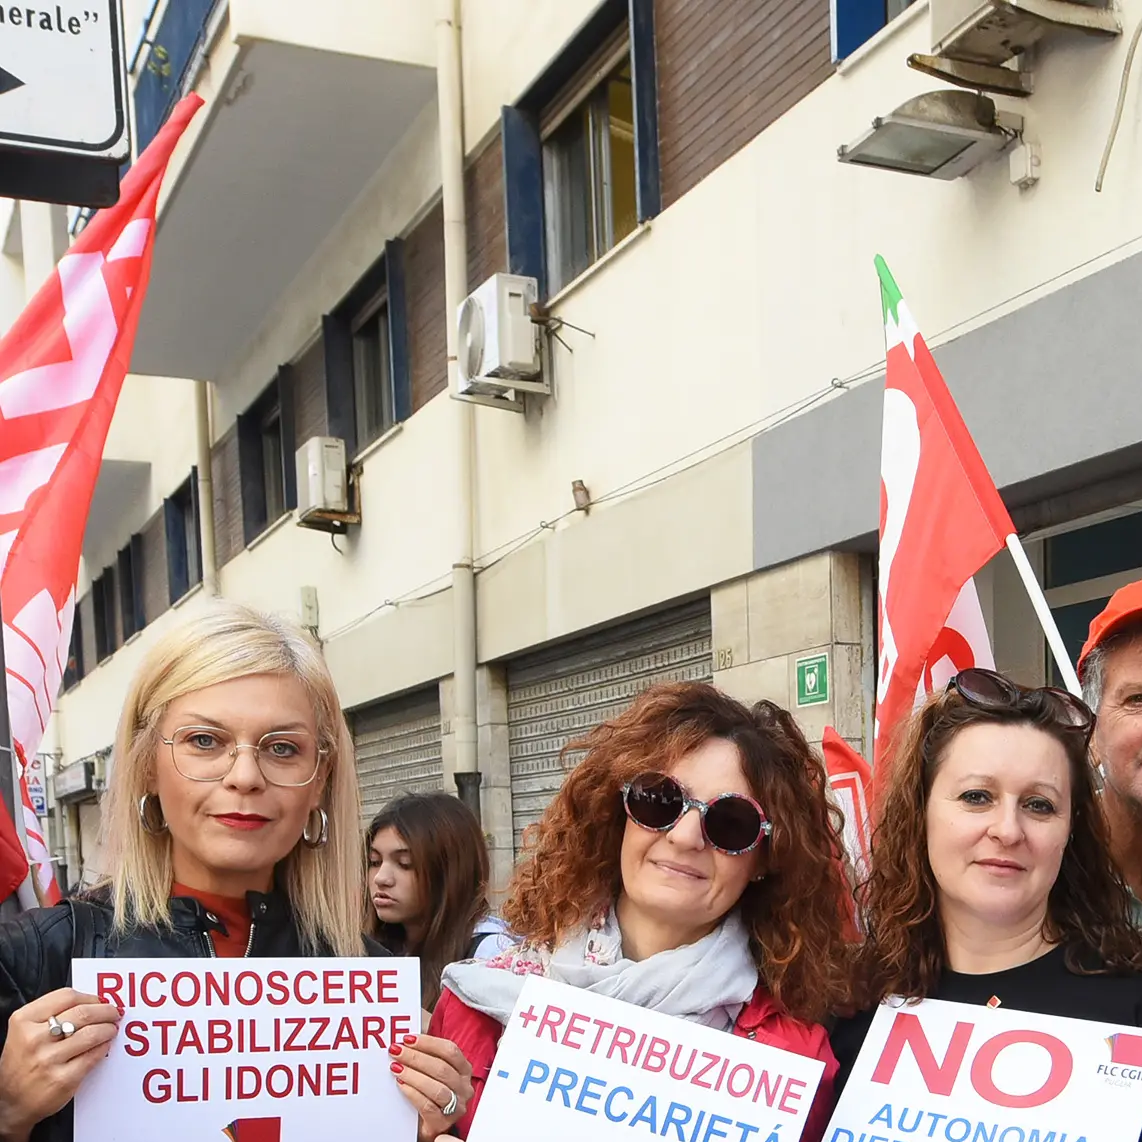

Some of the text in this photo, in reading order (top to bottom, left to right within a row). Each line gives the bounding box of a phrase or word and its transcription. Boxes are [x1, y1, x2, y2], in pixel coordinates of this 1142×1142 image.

[97, 970, 399, 1008] RICONOSCERE
[124, 1015, 411, 1056] STABILIZZARE
[870, 1012, 1074, 1109] NO
[1097, 1064, 1118, 1076] FLC
[143, 1062, 359, 1103] GLI IDONEI
